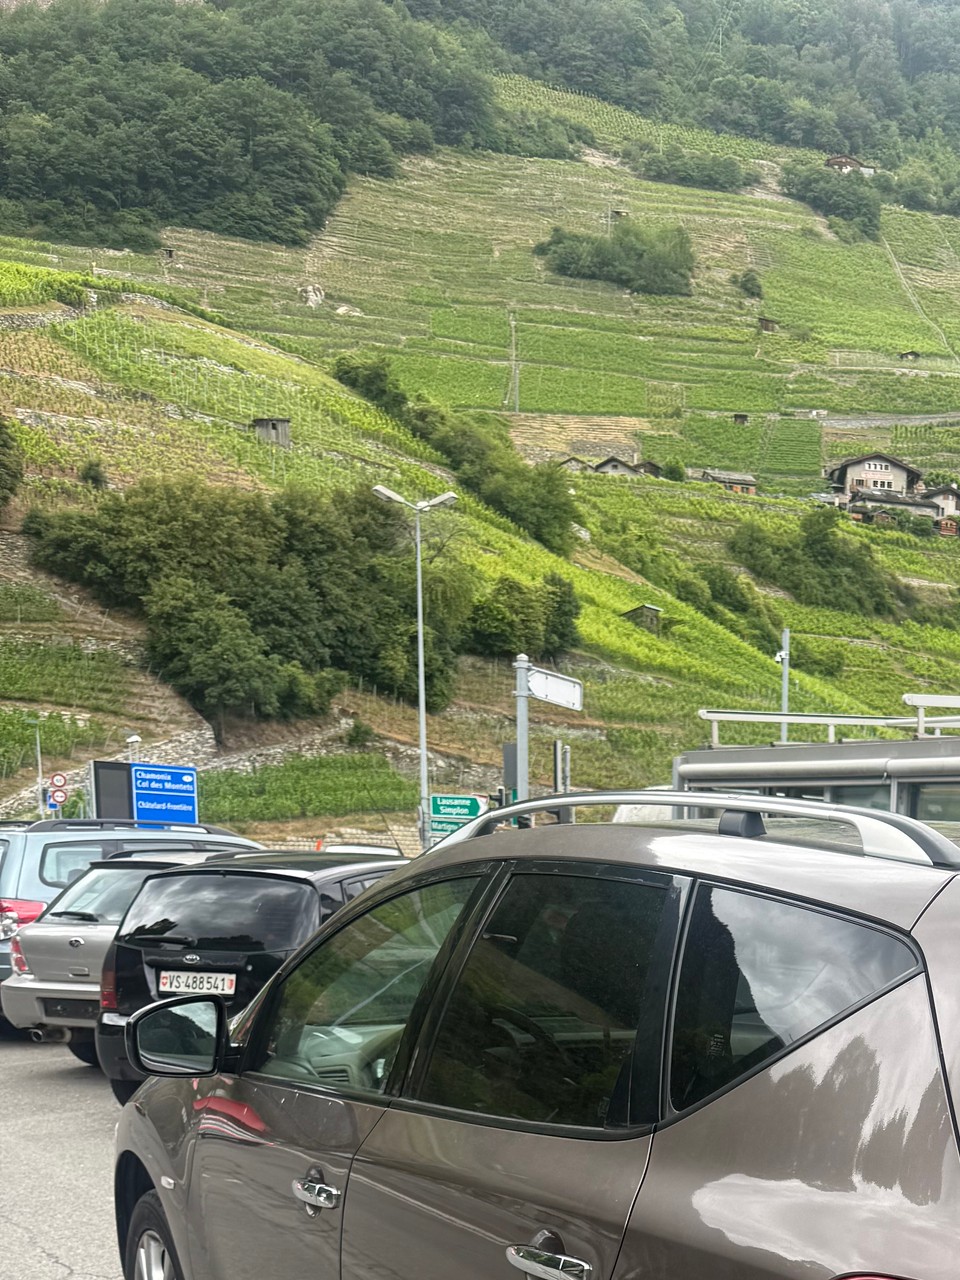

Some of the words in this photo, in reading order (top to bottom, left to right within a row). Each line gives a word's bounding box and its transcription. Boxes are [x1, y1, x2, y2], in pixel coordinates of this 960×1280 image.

[136, 771, 172, 780] Chamonix
[136, 780, 149, 788] Col
[150, 781, 163, 789] des
[164, 782, 193, 791] Montets
[437, 798, 471, 806] Lausanne
[439, 806, 470, 816] Simplon
